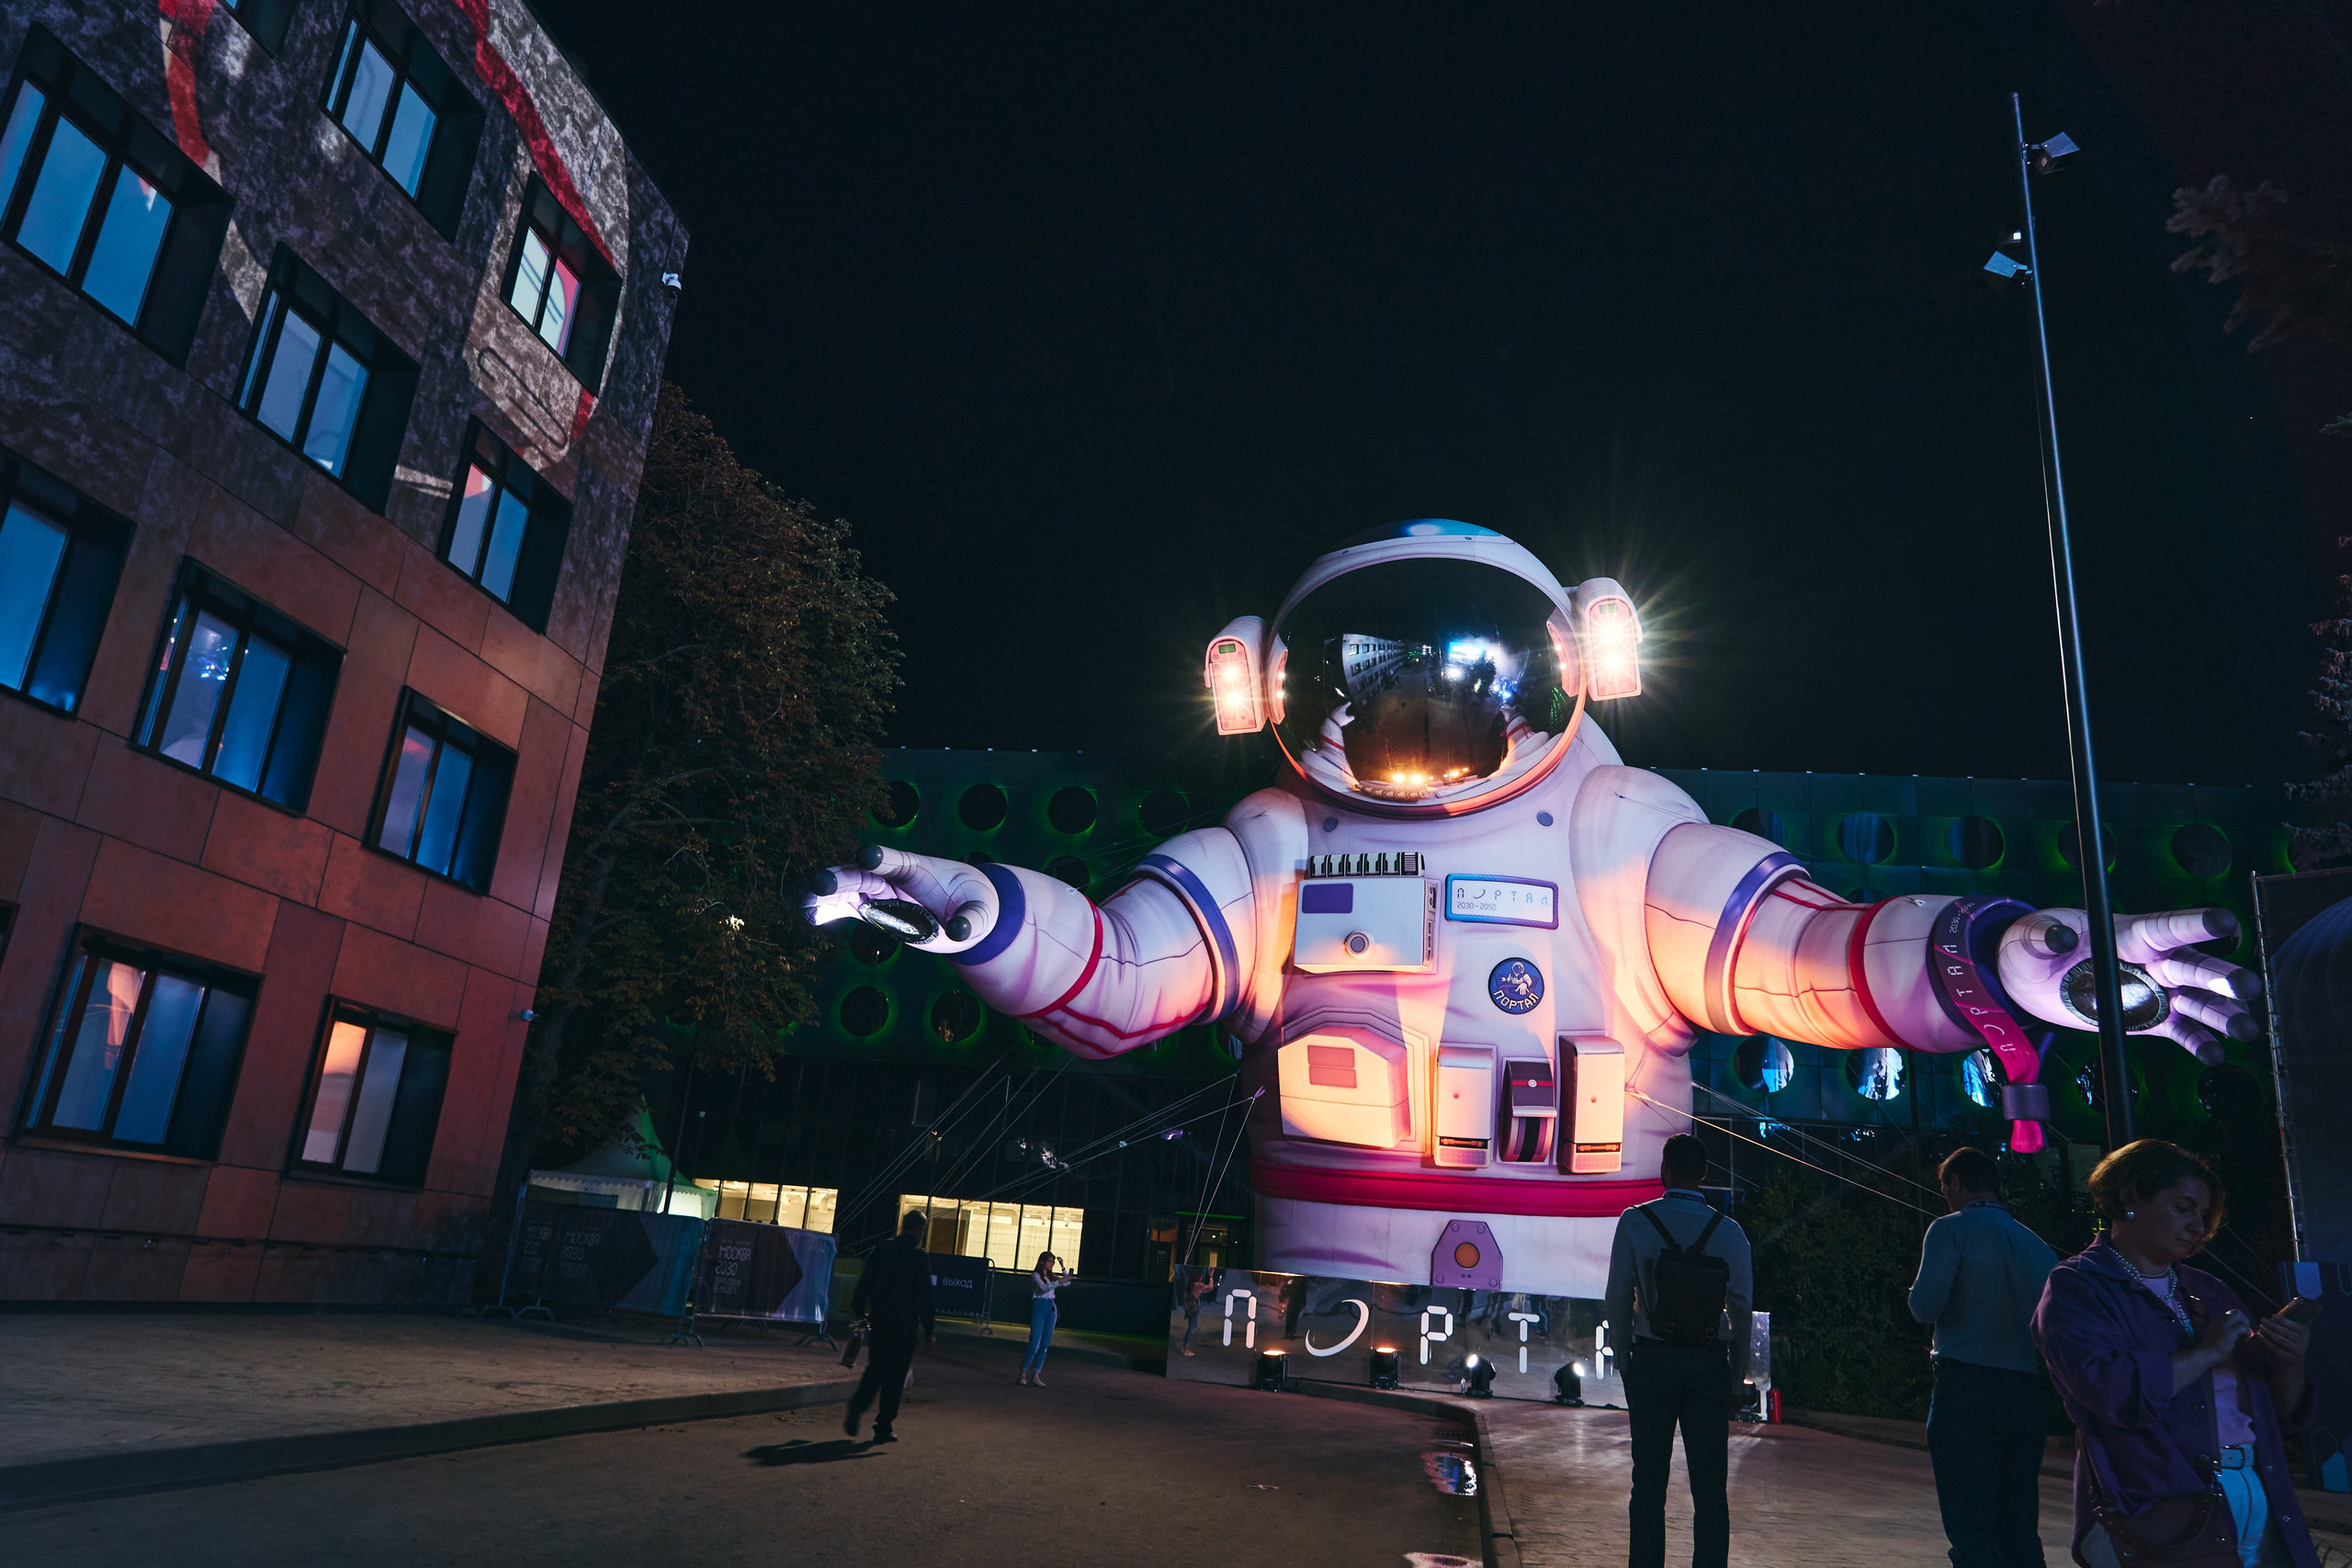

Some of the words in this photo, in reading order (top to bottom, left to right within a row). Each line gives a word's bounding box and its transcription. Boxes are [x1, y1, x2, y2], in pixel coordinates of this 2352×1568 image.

[1493, 989, 1540, 1010] ПОРТАЛ
[563, 1231, 601, 1247] МОСКВА
[560, 1245, 585, 1261] 2030
[718, 1245, 752, 1262] МОСКВА
[715, 1259, 739, 1277] 2030
[943, 1277, 973, 1289] ВЫХОД
[1223, 1289, 1614, 1380] ПОРТ
